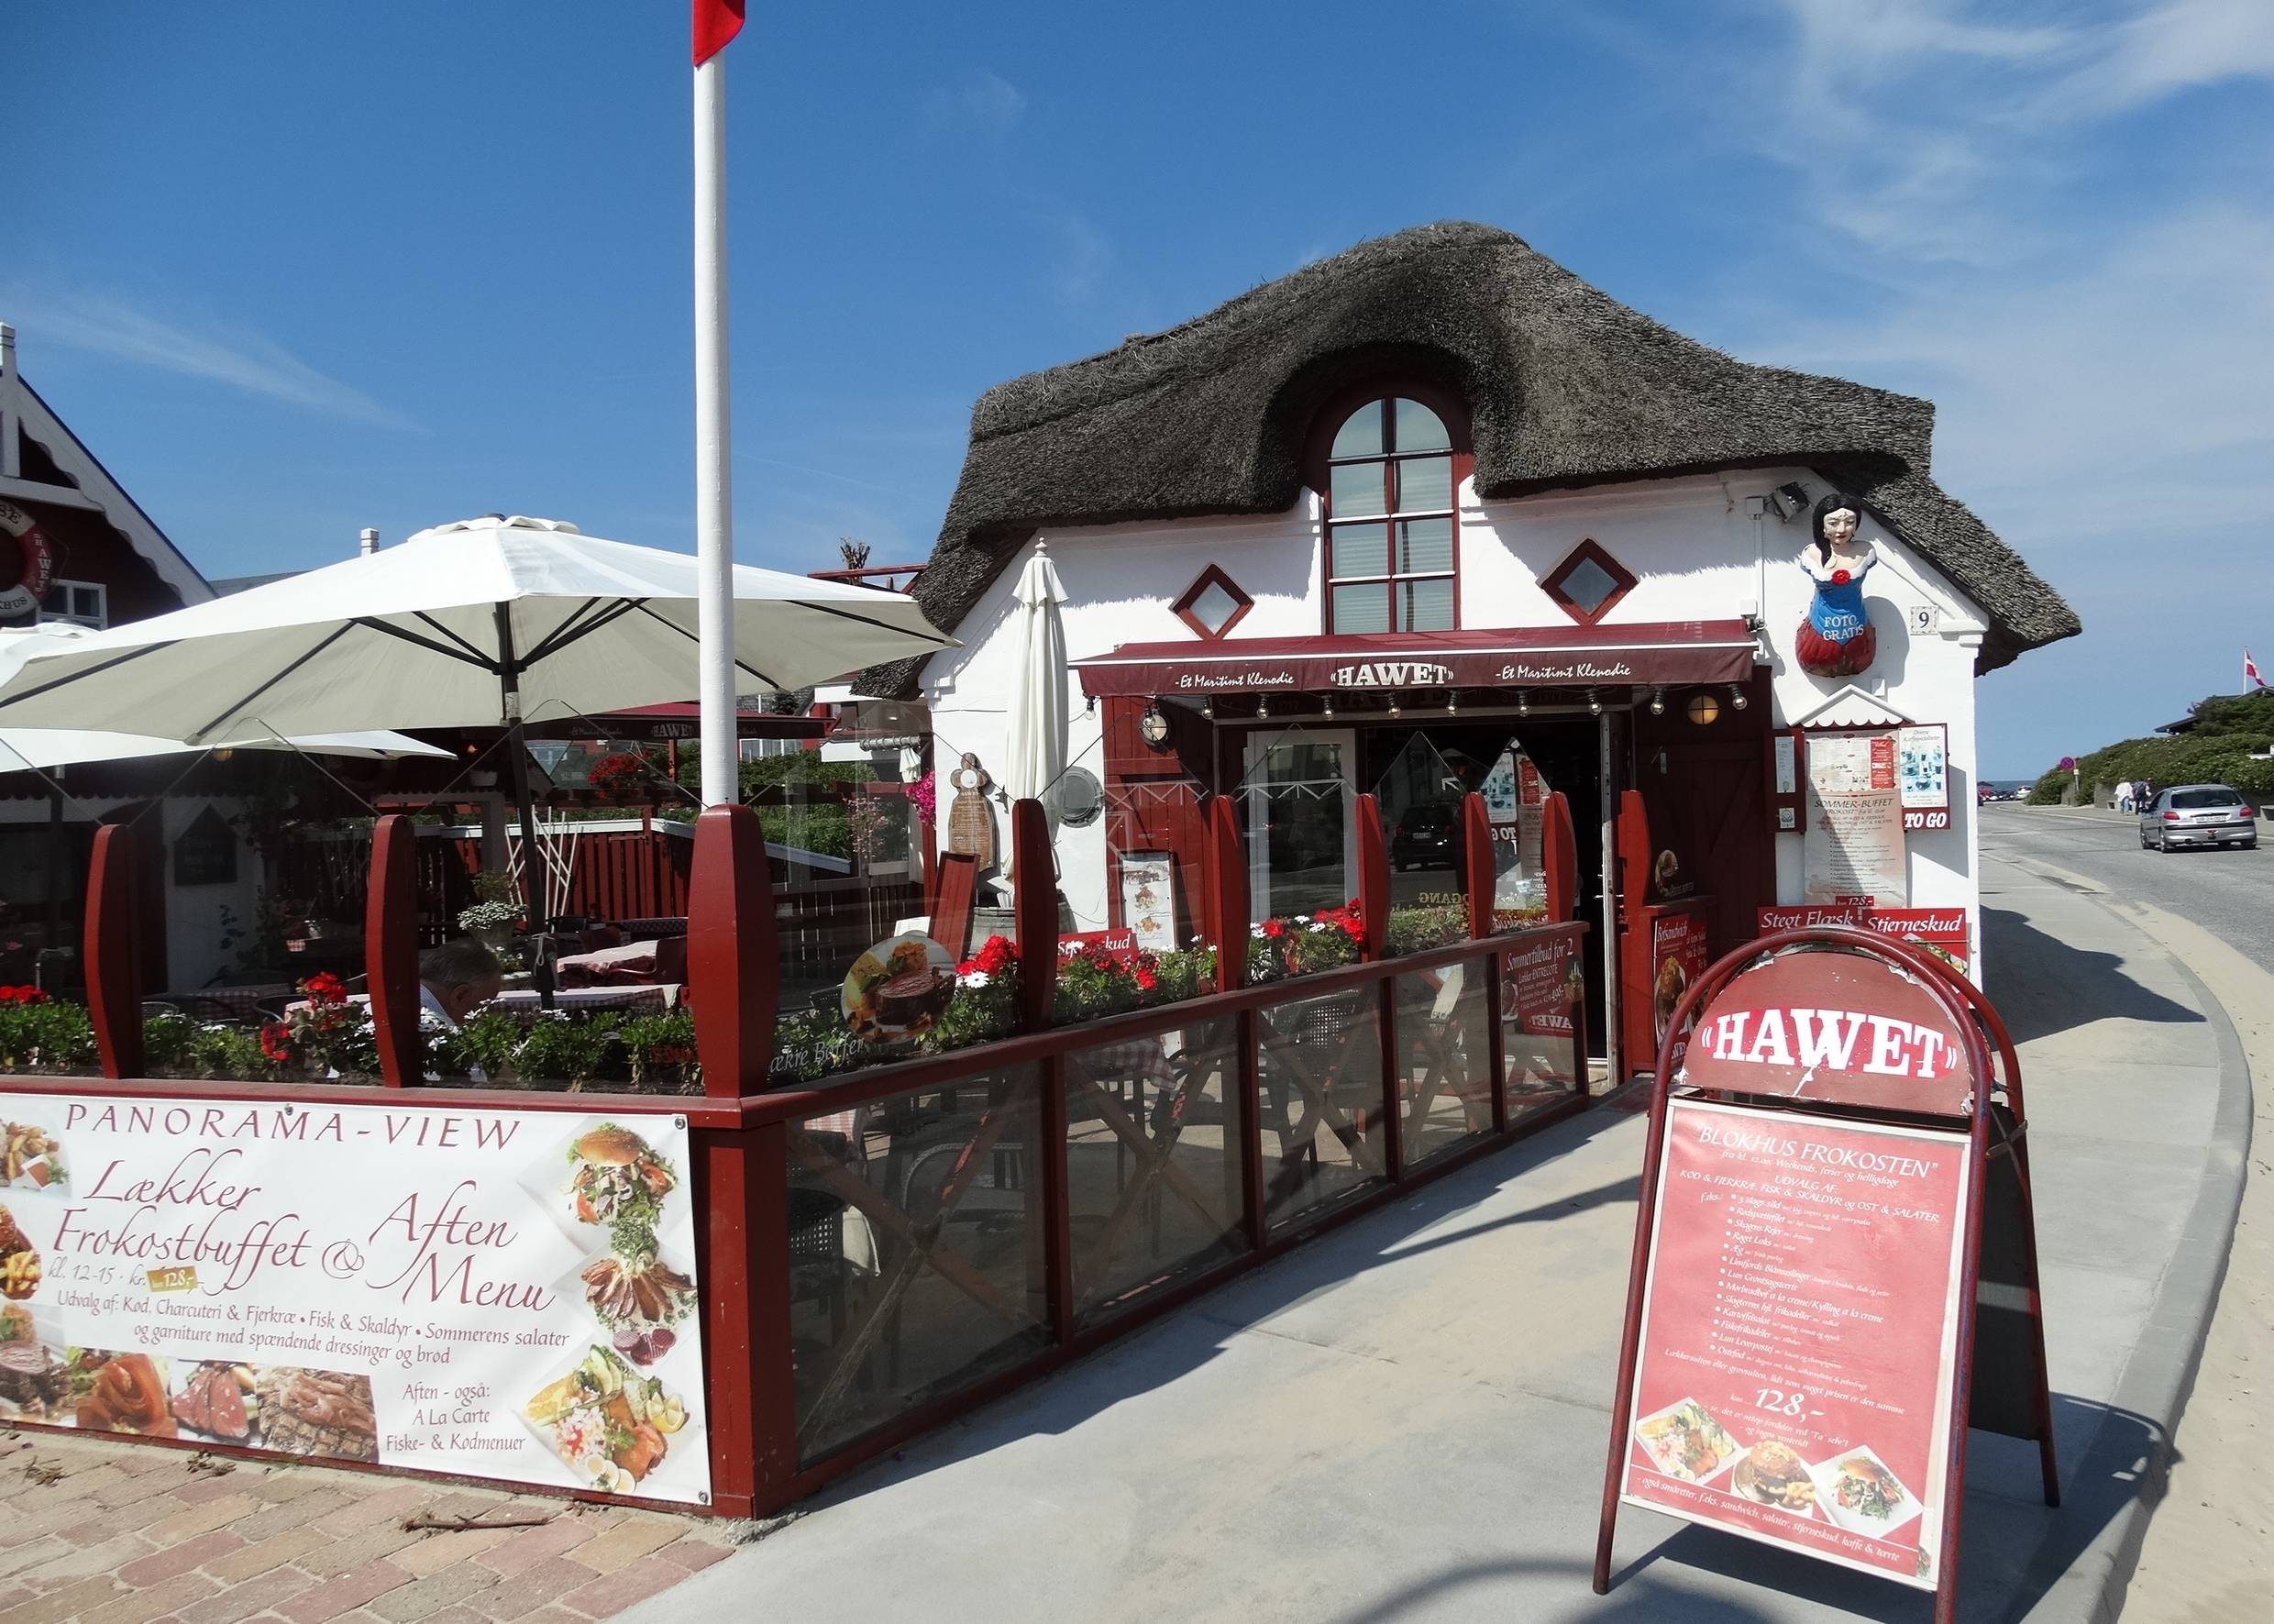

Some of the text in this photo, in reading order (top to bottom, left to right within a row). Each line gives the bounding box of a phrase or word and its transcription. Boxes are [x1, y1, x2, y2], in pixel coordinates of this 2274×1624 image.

[1824, 615, 1859, 628] FOTO
[1918, 611, 1930, 628] 9
[1822, 624, 1864, 641] GRATIS
[1194, 674, 1243, 688] Maritimt
[1247, 671, 1294, 686] Klenodie
[1518, 663, 1573, 679] Maritimt
[1576, 661, 1631, 678] Klenodie
[1814, 798, 1894, 808] SOMMER-BUFFET
[1904, 812, 1925, 828] TO
[1926, 812, 1947, 828] GO
[1867, 914, 1963, 934] Stjerneskud
[65, 1103, 521, 1150] PANORAMA-VIEW
[83, 1147, 261, 1209] Lækker
[1774, 1175, 1820, 1190] UDVALG
[1844, 1171, 1855, 1183] og
[1703, 1174, 1712, 1183] &
[1760, 1183, 1782, 1196] FISK
[1783, 1188, 1793, 1198] &
[1795, 1189, 1843, 1207] SKALDYR
[1857, 1201, 1880, 1211] OST
[1881, 1205, 1890, 1215] &
[1892, 1207, 1940, 1223] SALATER
[365, 1179, 519, 1290] Aften
[53, 1205, 364, 1296] Frokostbuffet &
[73, 1265, 116, 1285] 12-15
[402, 1251, 557, 1312] Menu
[57, 1290, 101, 1316] Udvalg
[156, 1298, 222, 1320] Charcuteri
[227, 1305, 240, 1321] &
[246, 1305, 296, 1327] Fjerkræ
[309, 1310, 335, 1329] Fisk
[340, 1313, 354, 1331] &
[358, 1315, 412, 1343] Skaldyr
[425, 1322, 510, 1345] Sommerens
[514, 1328, 570, 1347] salater
[135, 1326, 149, 1344] og
[151, 1325, 212, 1345] garniture
[215, 1327, 244, 1345] med
[248, 1332, 323, 1352] spændende
[325, 1333, 392, 1365] dressinger
[395, 1348, 413, 1369] og
[403, 1380, 438, 1405] Aften
[412, 1408, 491, 1427] A La Carte
[386, 1433, 426, 1453] Fiske-
[431, 1432, 446, 1452] &
[1864, 1542, 1874, 1555] &
